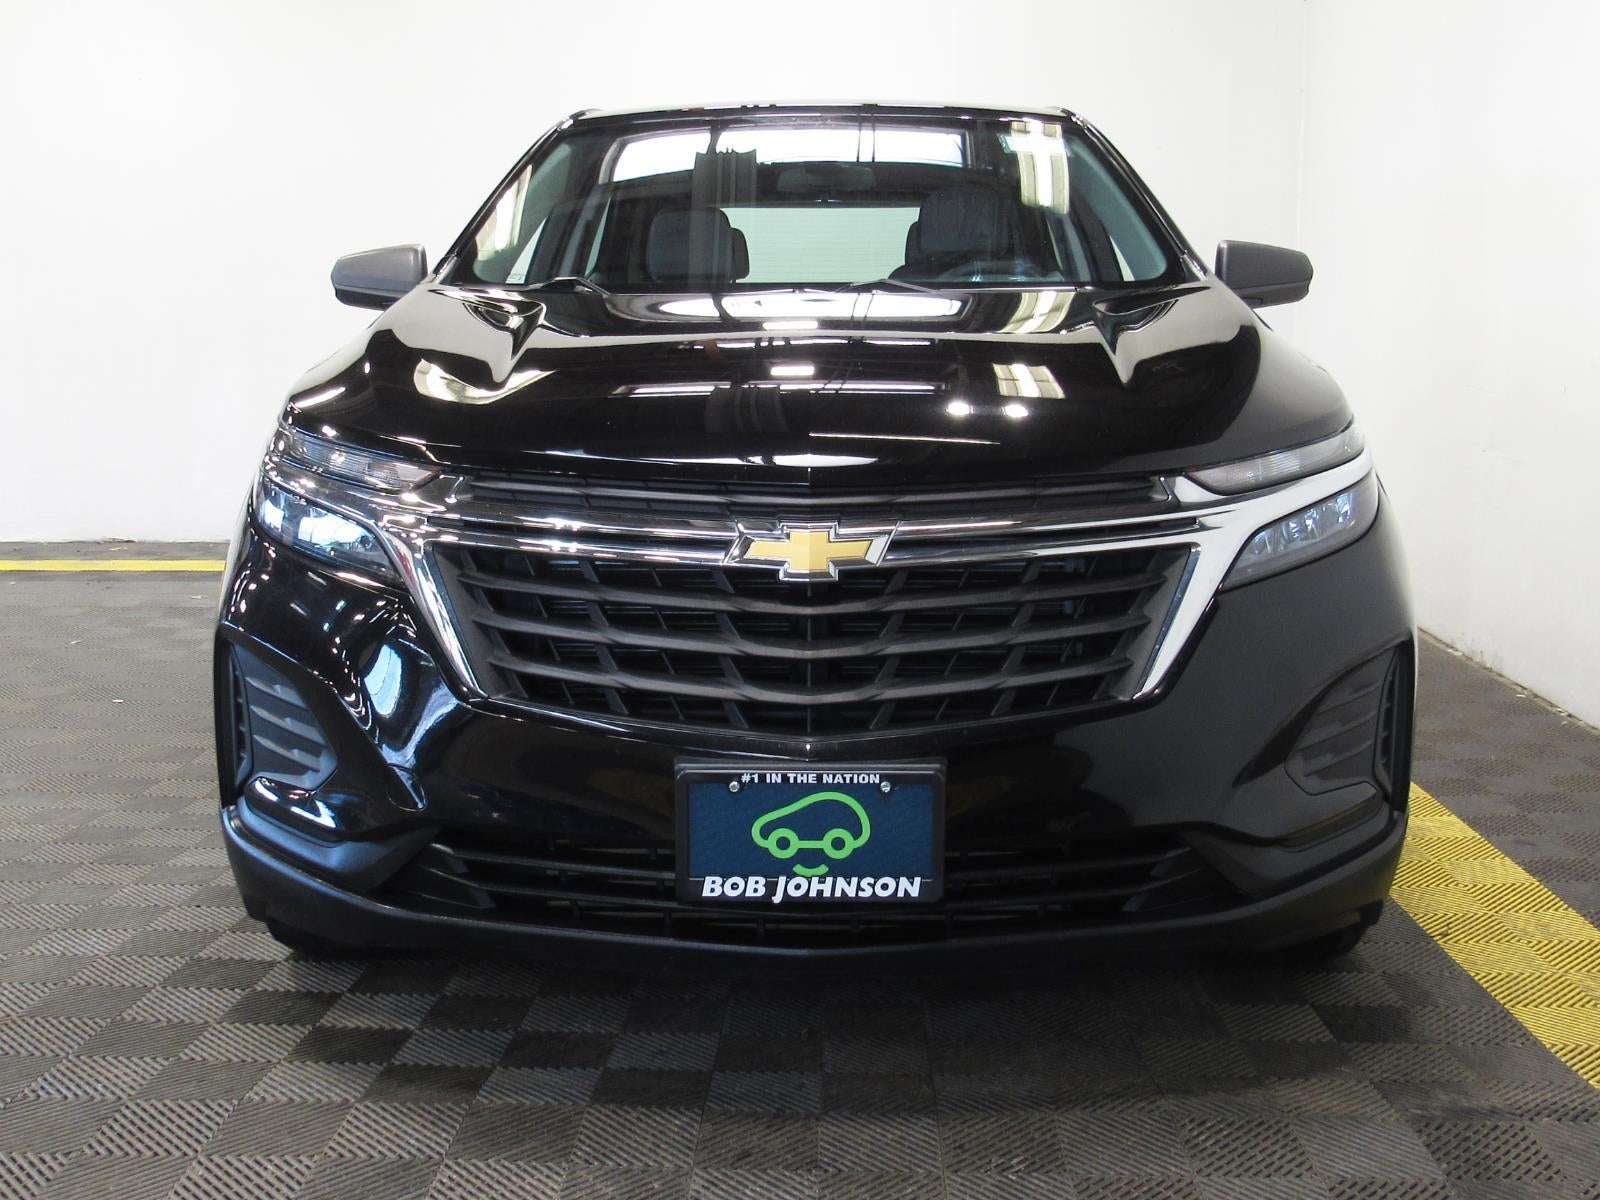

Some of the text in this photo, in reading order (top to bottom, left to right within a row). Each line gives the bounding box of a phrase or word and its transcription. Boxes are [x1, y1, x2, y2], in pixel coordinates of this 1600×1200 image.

[741, 773, 880, 784] #1 IN THE NATION
[702, 876, 921, 903] BOB JOHNSON
